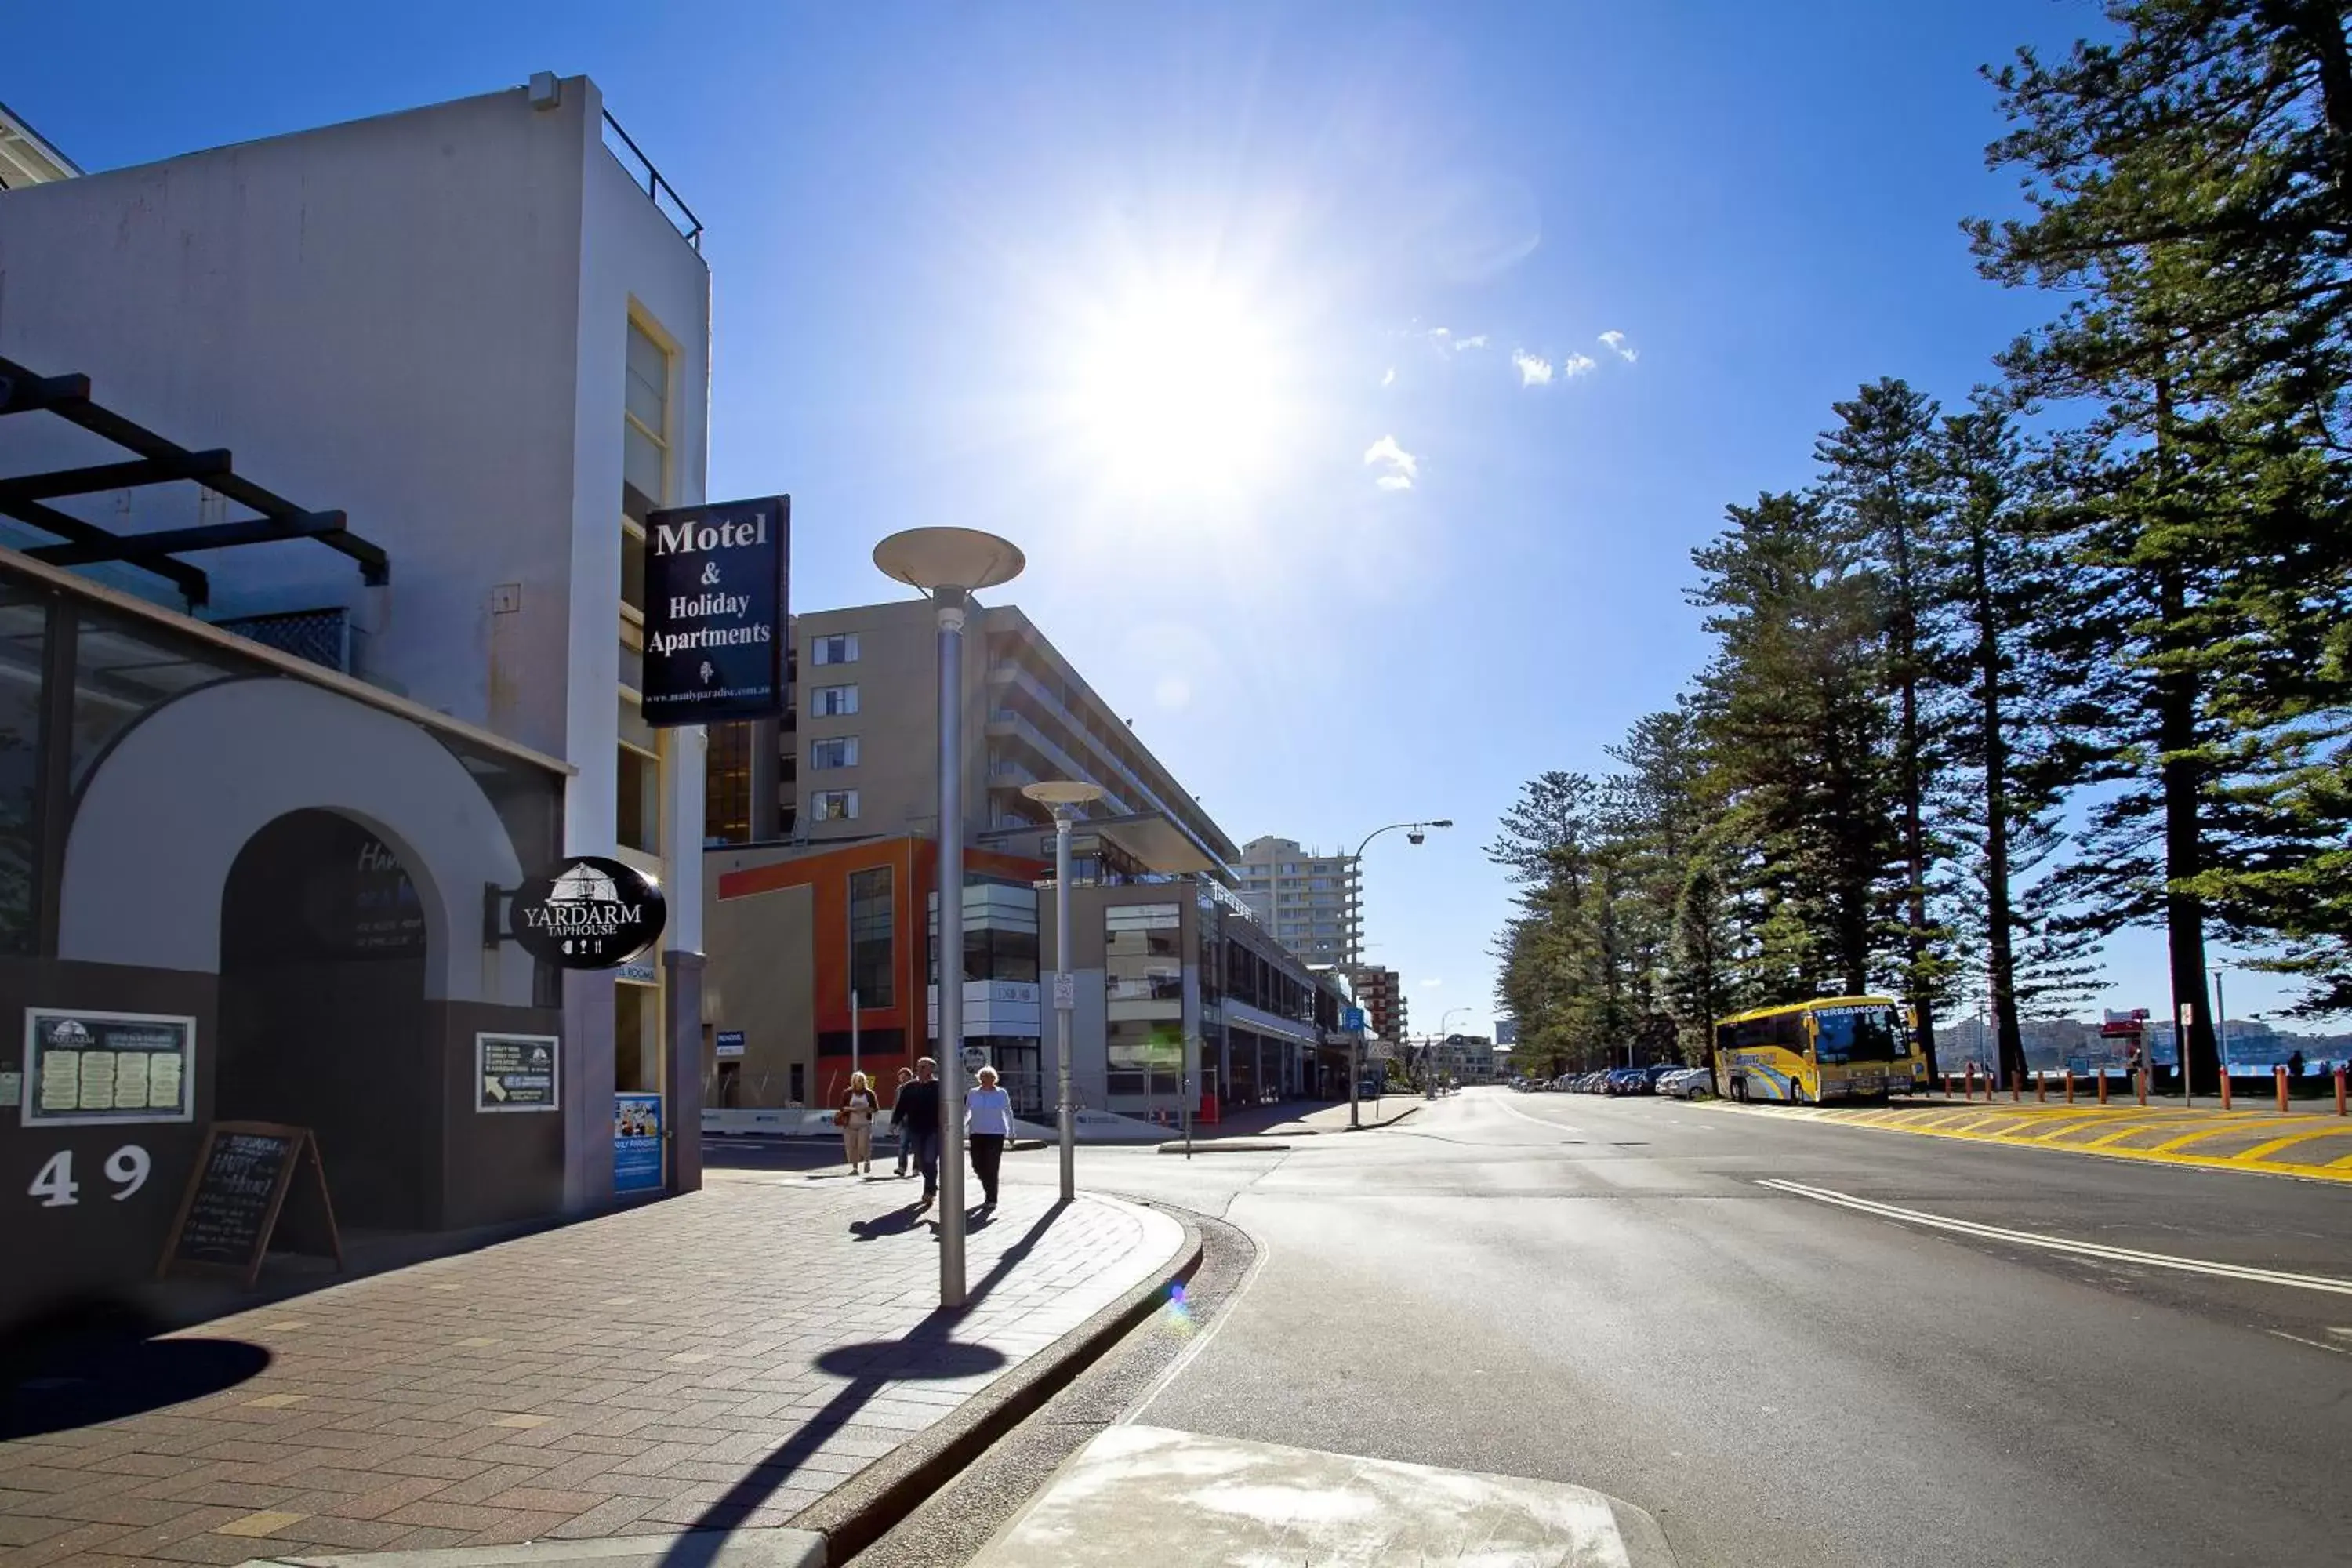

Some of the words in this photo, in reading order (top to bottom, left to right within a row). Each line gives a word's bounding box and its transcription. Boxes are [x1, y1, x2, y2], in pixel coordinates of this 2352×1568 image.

[654, 514, 768, 556] Motel
[700, 561, 720, 585] &
[669, 592, 750, 619] Holiday
[649, 622, 771, 656] Apartments
[524, 904, 642, 927] YARDARM
[547, 924, 618, 937] TAPHOUSE
[1815, 1004, 1893, 1018] TERRANOVA
[27, 1145, 151, 1207] 49
